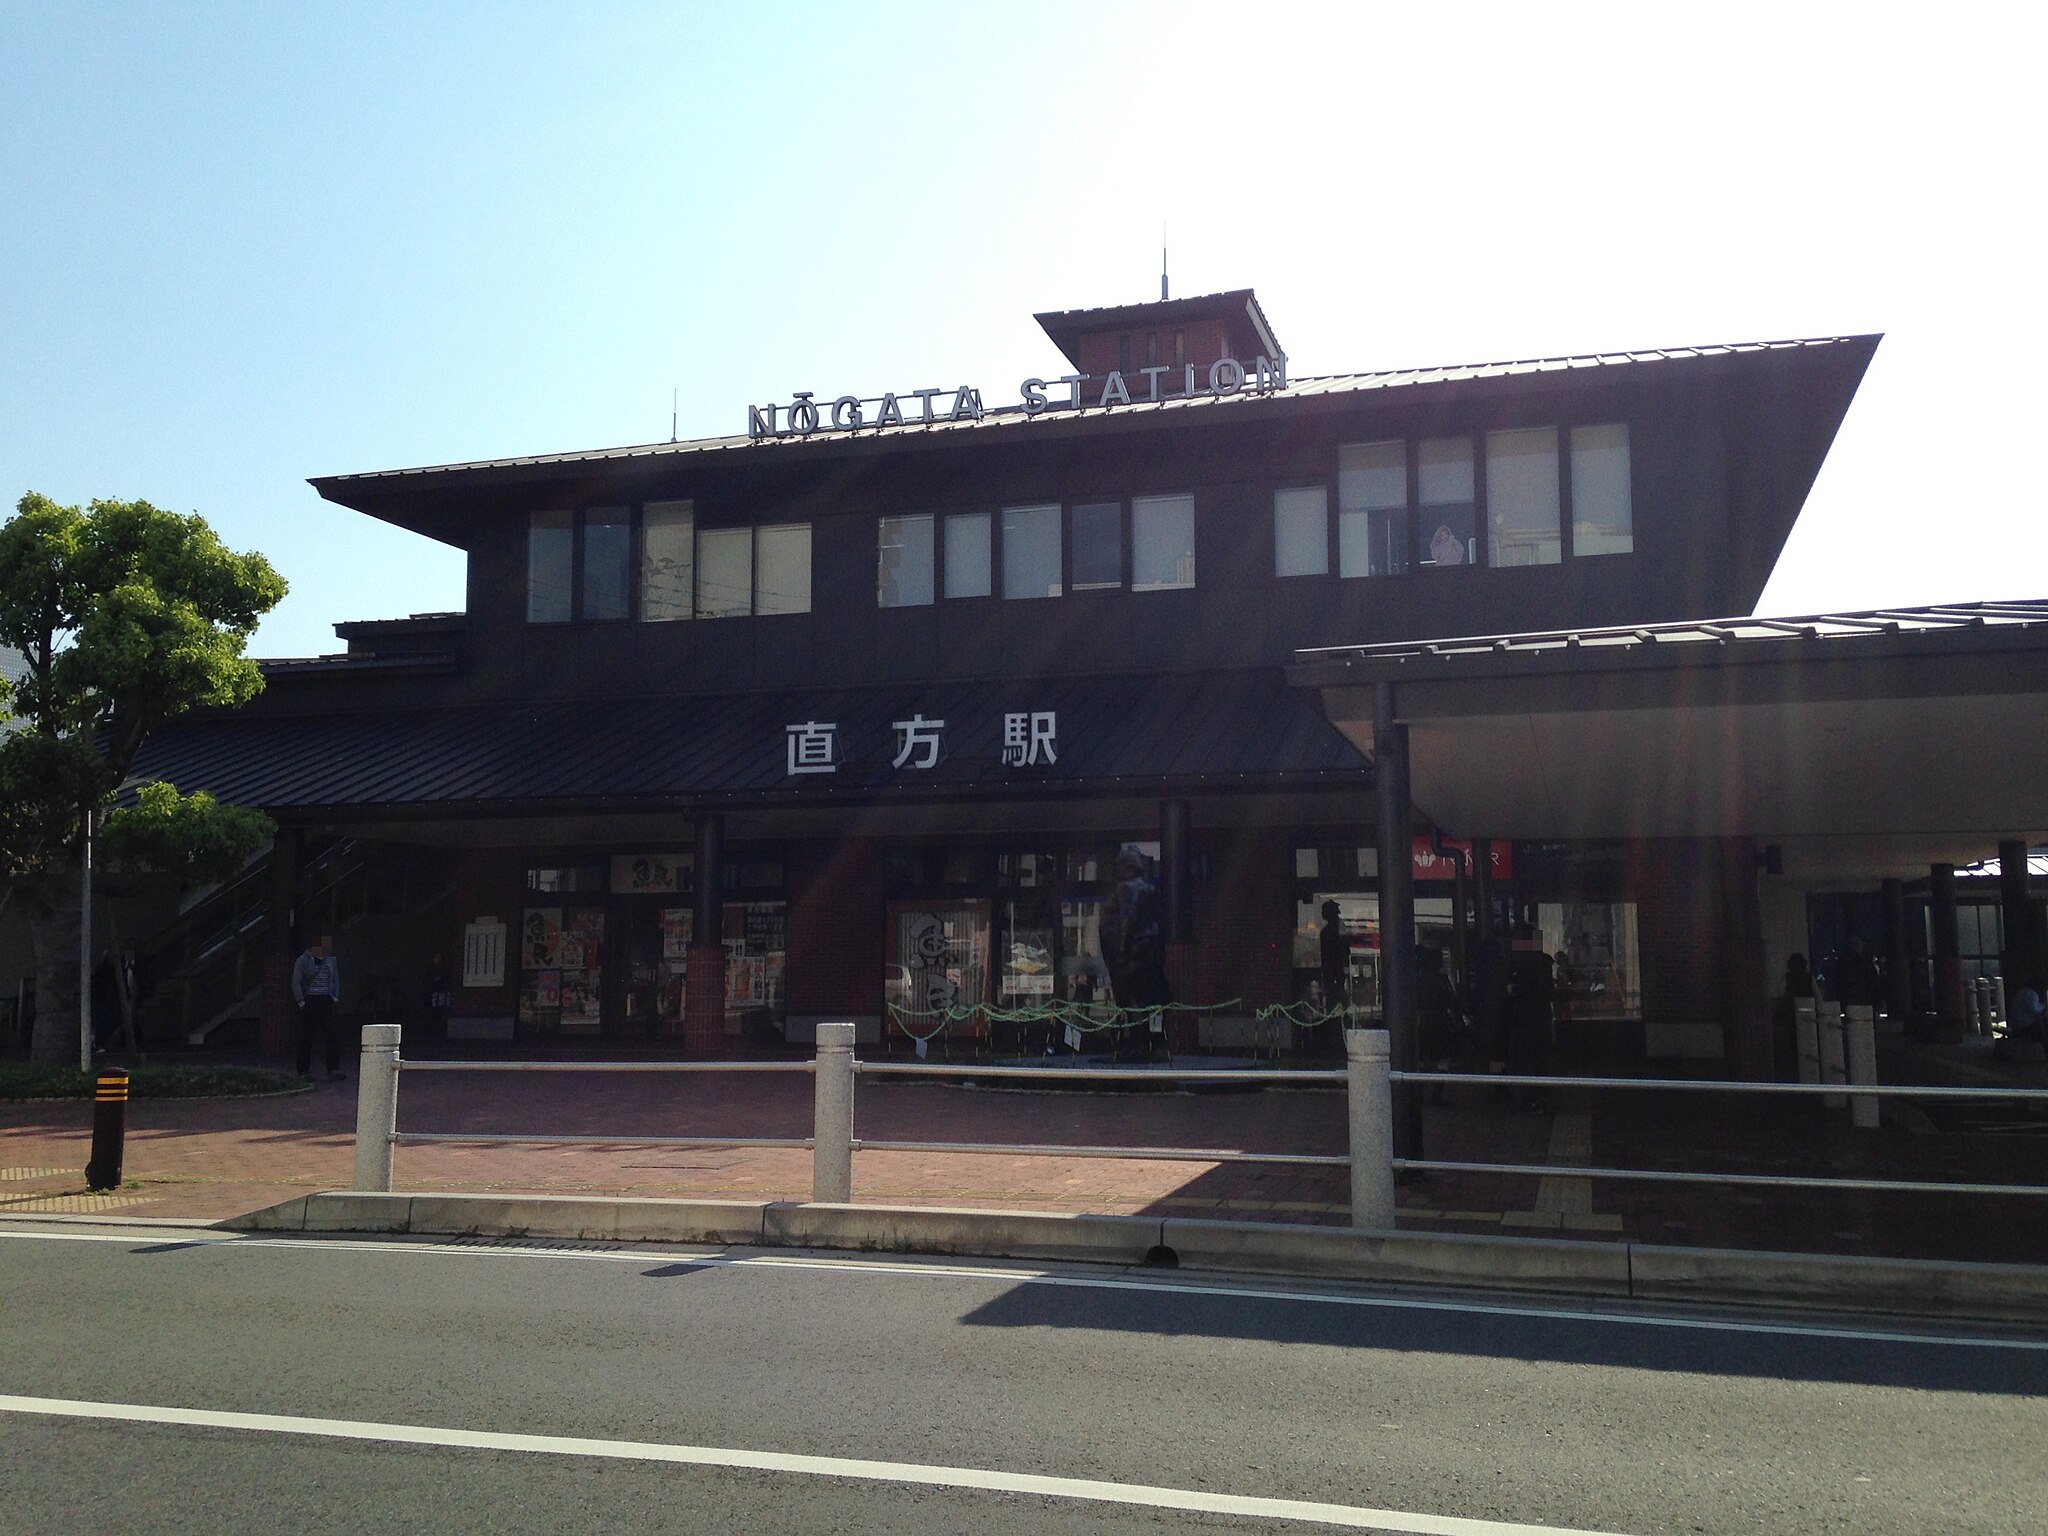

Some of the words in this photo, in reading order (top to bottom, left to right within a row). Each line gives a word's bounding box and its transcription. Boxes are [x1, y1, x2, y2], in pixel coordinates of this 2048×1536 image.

[1020, 352, 1288, 414] STATION
[786, 711, 1057, 775] 直方駅
